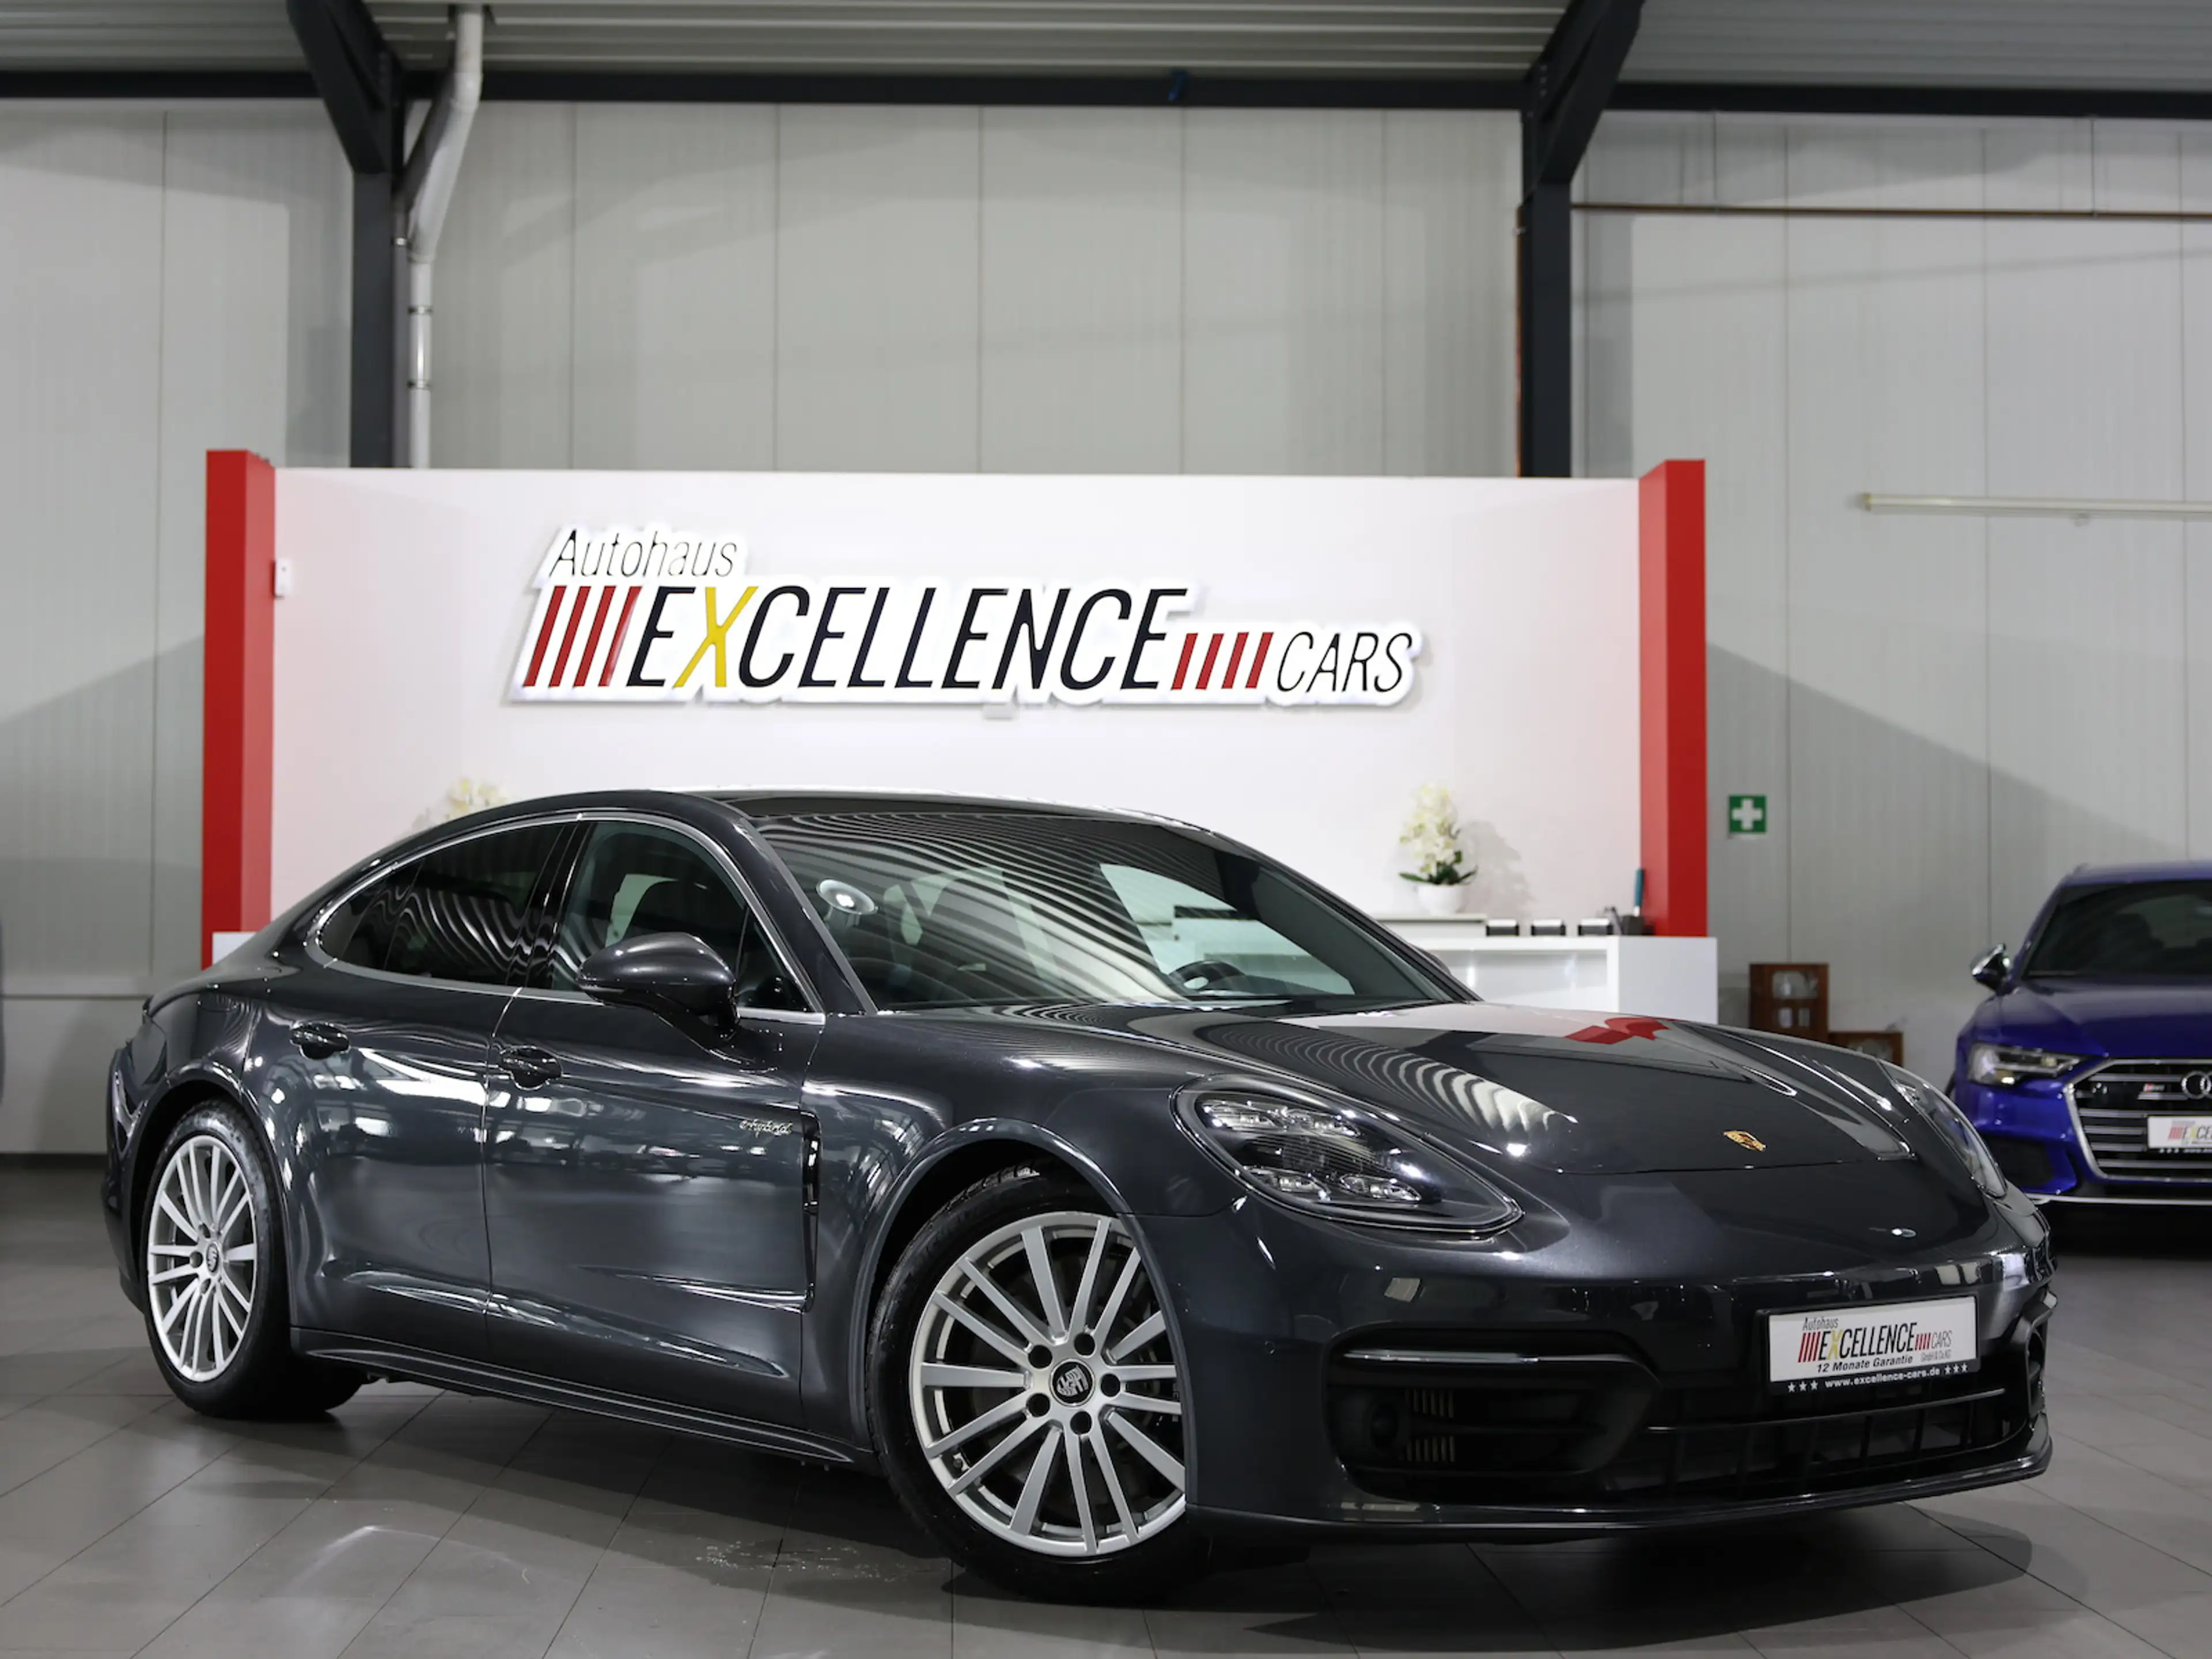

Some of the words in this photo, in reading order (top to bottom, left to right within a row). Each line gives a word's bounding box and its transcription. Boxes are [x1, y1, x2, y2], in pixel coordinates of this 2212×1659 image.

[550, 528, 737, 577] Autohaus
[626, 585, 1188, 691] EXCELLENCE
[1276, 631, 1412, 693] CARS
[1802, 1317, 1839, 1331] Autohaus
[1818, 1321, 1917, 1361] EXCELLENCE
[1931, 1330, 1952, 1349] CARS
[1816, 1363, 1829, 1373] 12
[1832, 1359, 1870, 1372] Monate
[1873, 1355, 1913, 1368] Garantie
[1824, 1366, 1941, 1388] www.excellence-cars.de
